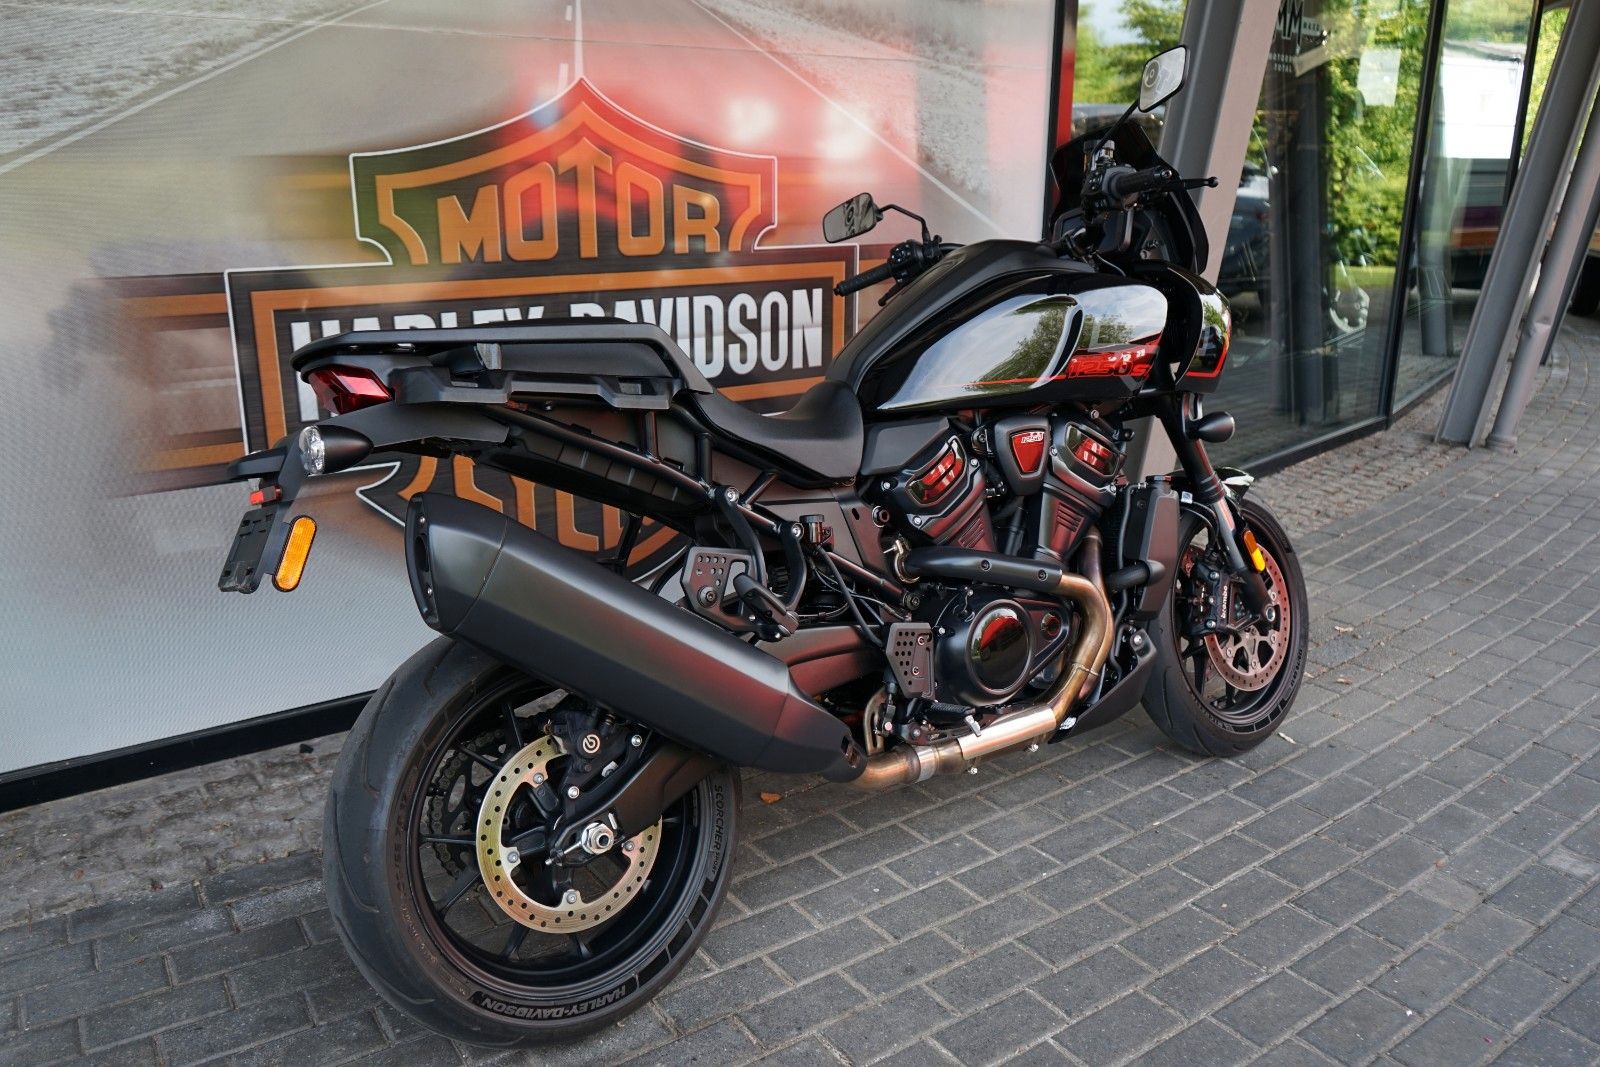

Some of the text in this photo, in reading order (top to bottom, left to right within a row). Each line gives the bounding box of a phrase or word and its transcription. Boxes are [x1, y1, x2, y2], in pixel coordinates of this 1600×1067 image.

[437, 137, 720, 264] MOTOR
[713, 784, 724, 851] SCORCHER
[481, 984, 626, 1020] HARLEY-DAVIDSON
